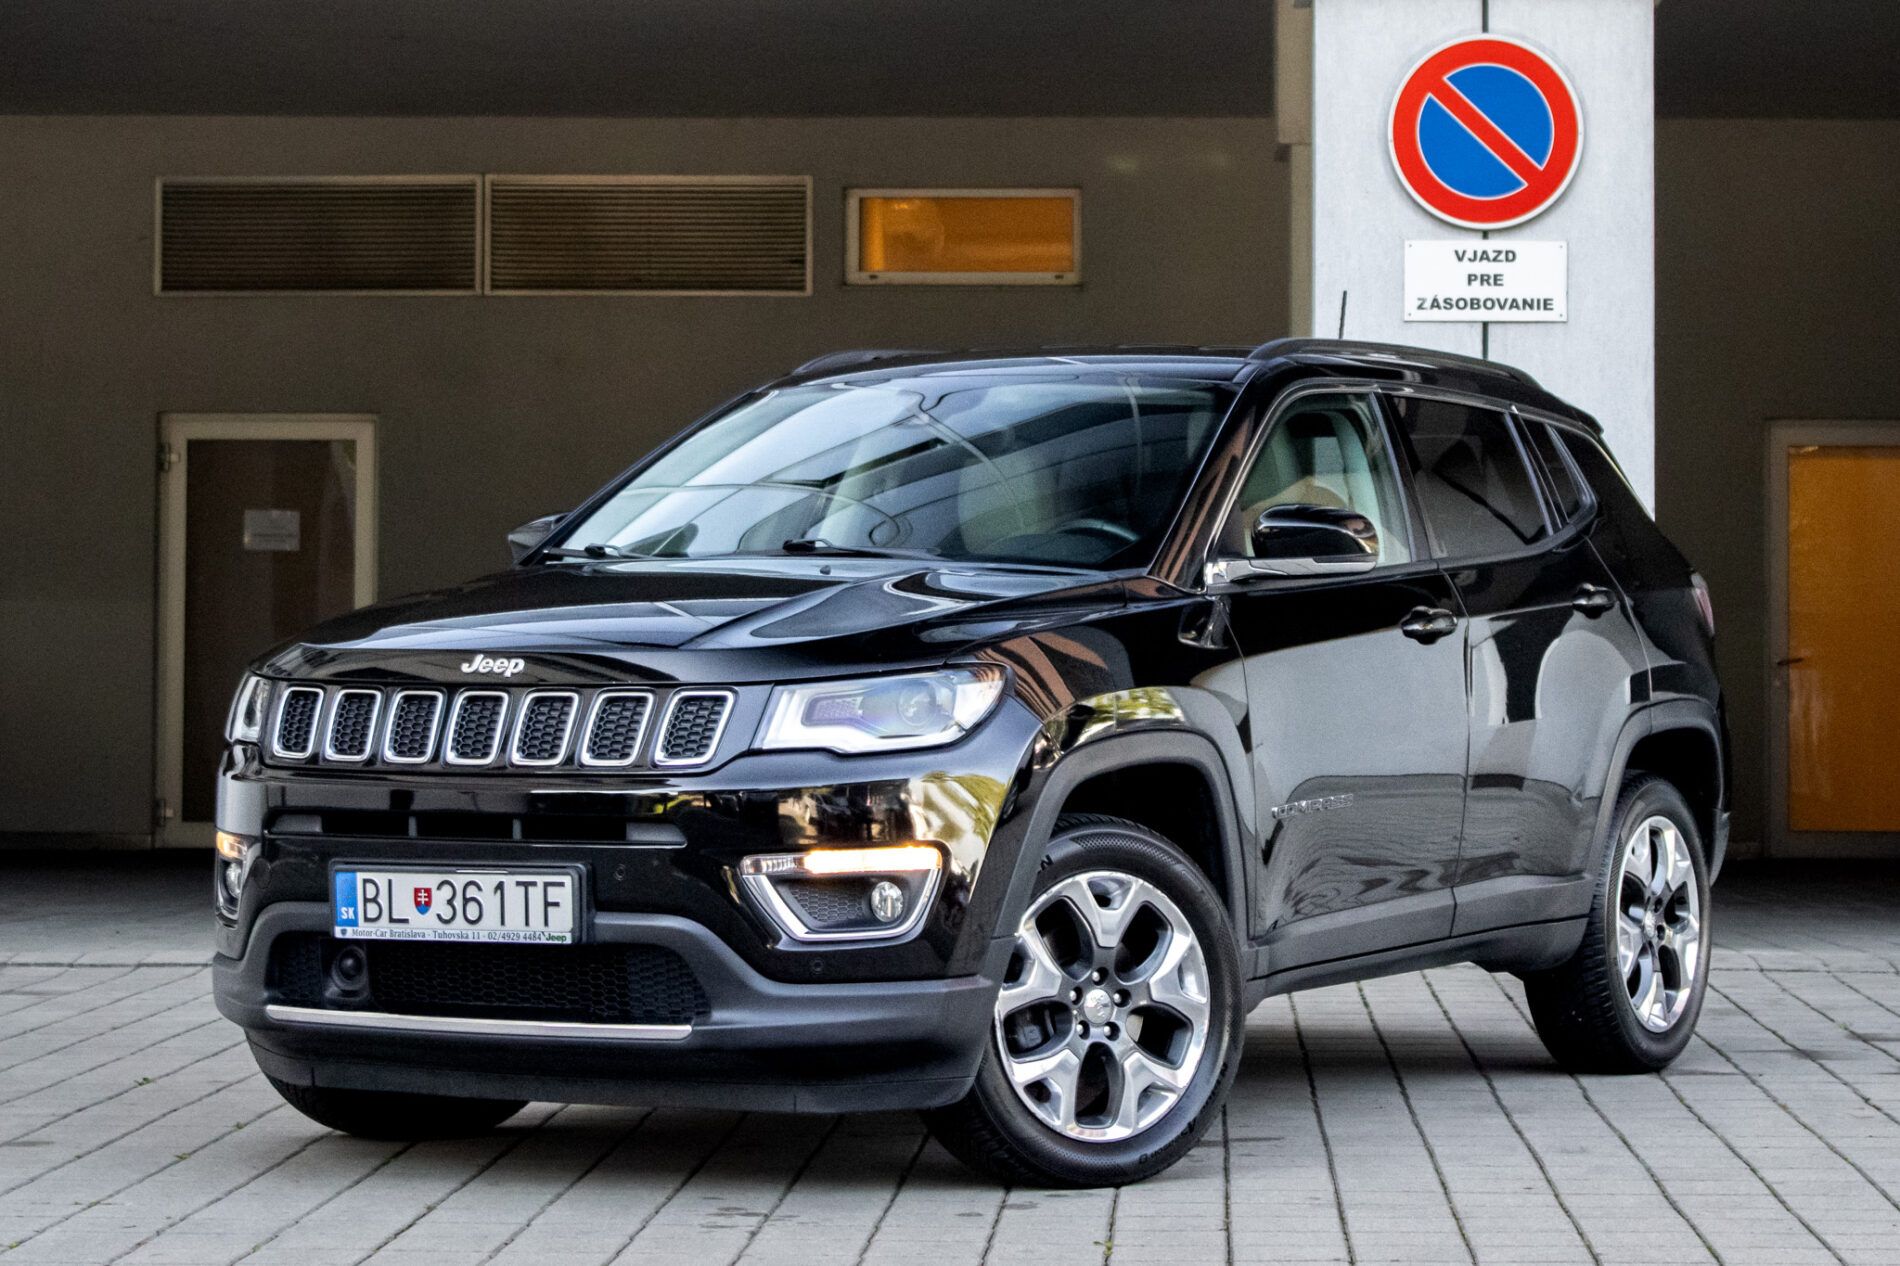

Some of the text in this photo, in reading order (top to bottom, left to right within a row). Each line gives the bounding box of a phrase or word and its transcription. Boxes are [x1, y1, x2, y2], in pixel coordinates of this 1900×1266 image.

[1454, 249, 1517, 263] VJAZD
[1466, 273, 1504, 287] PRE
[1416, 294, 1554, 311] ZÁSOBOVANIE
[461, 653, 526, 678] Jeep
[362, 878, 566, 928] BL 361TF
[340, 906, 356, 920] SK
[351, 928, 387, 938] Motor-Car
[389, 928, 426, 939] Bratislava
[545, 932, 567, 943] Jeep
